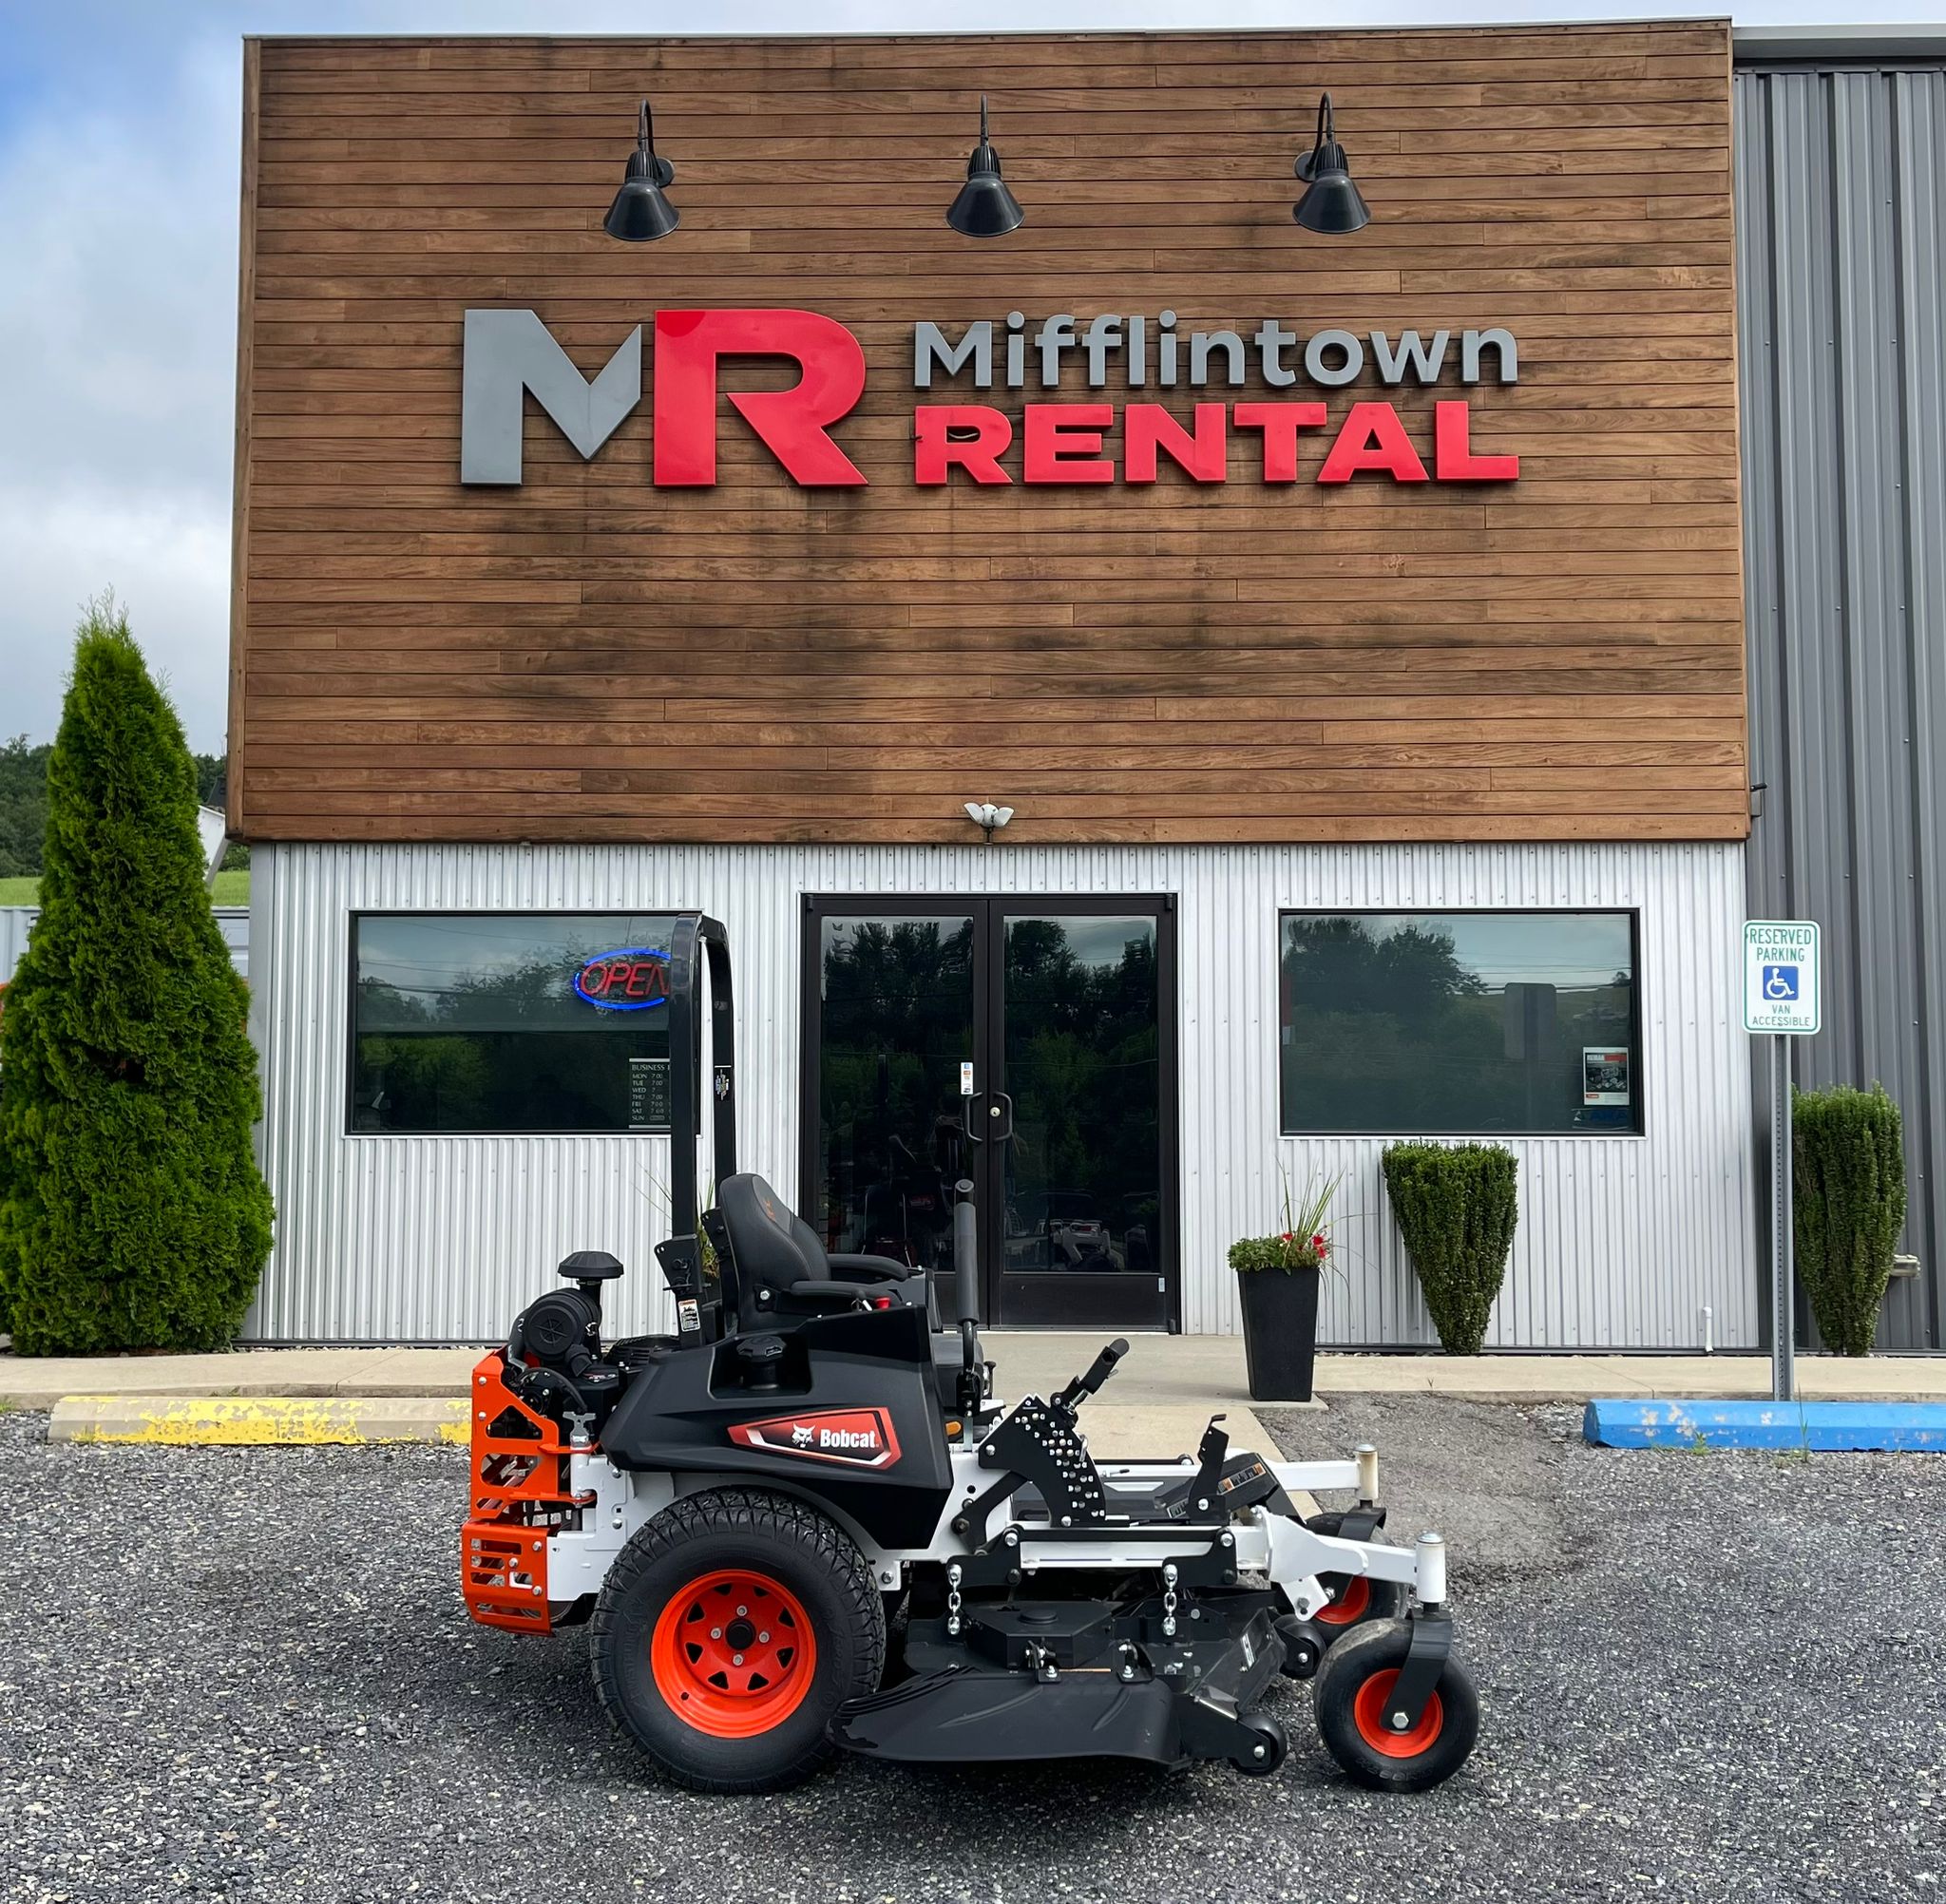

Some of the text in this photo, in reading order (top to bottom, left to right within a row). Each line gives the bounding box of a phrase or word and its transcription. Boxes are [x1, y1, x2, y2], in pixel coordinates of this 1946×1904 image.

[914, 310, 1518, 388] Mifflintown
[914, 400, 1520, 486] RENTAL
[1749, 928, 1812, 944] RESERVED
[1756, 947, 1805, 962] PARKING
[1772, 1005, 1791, 1014] VAN
[1752, 1016, 1810, 1026] ACCESSIBLE
[820, 1429, 876, 1448] Bobcat
